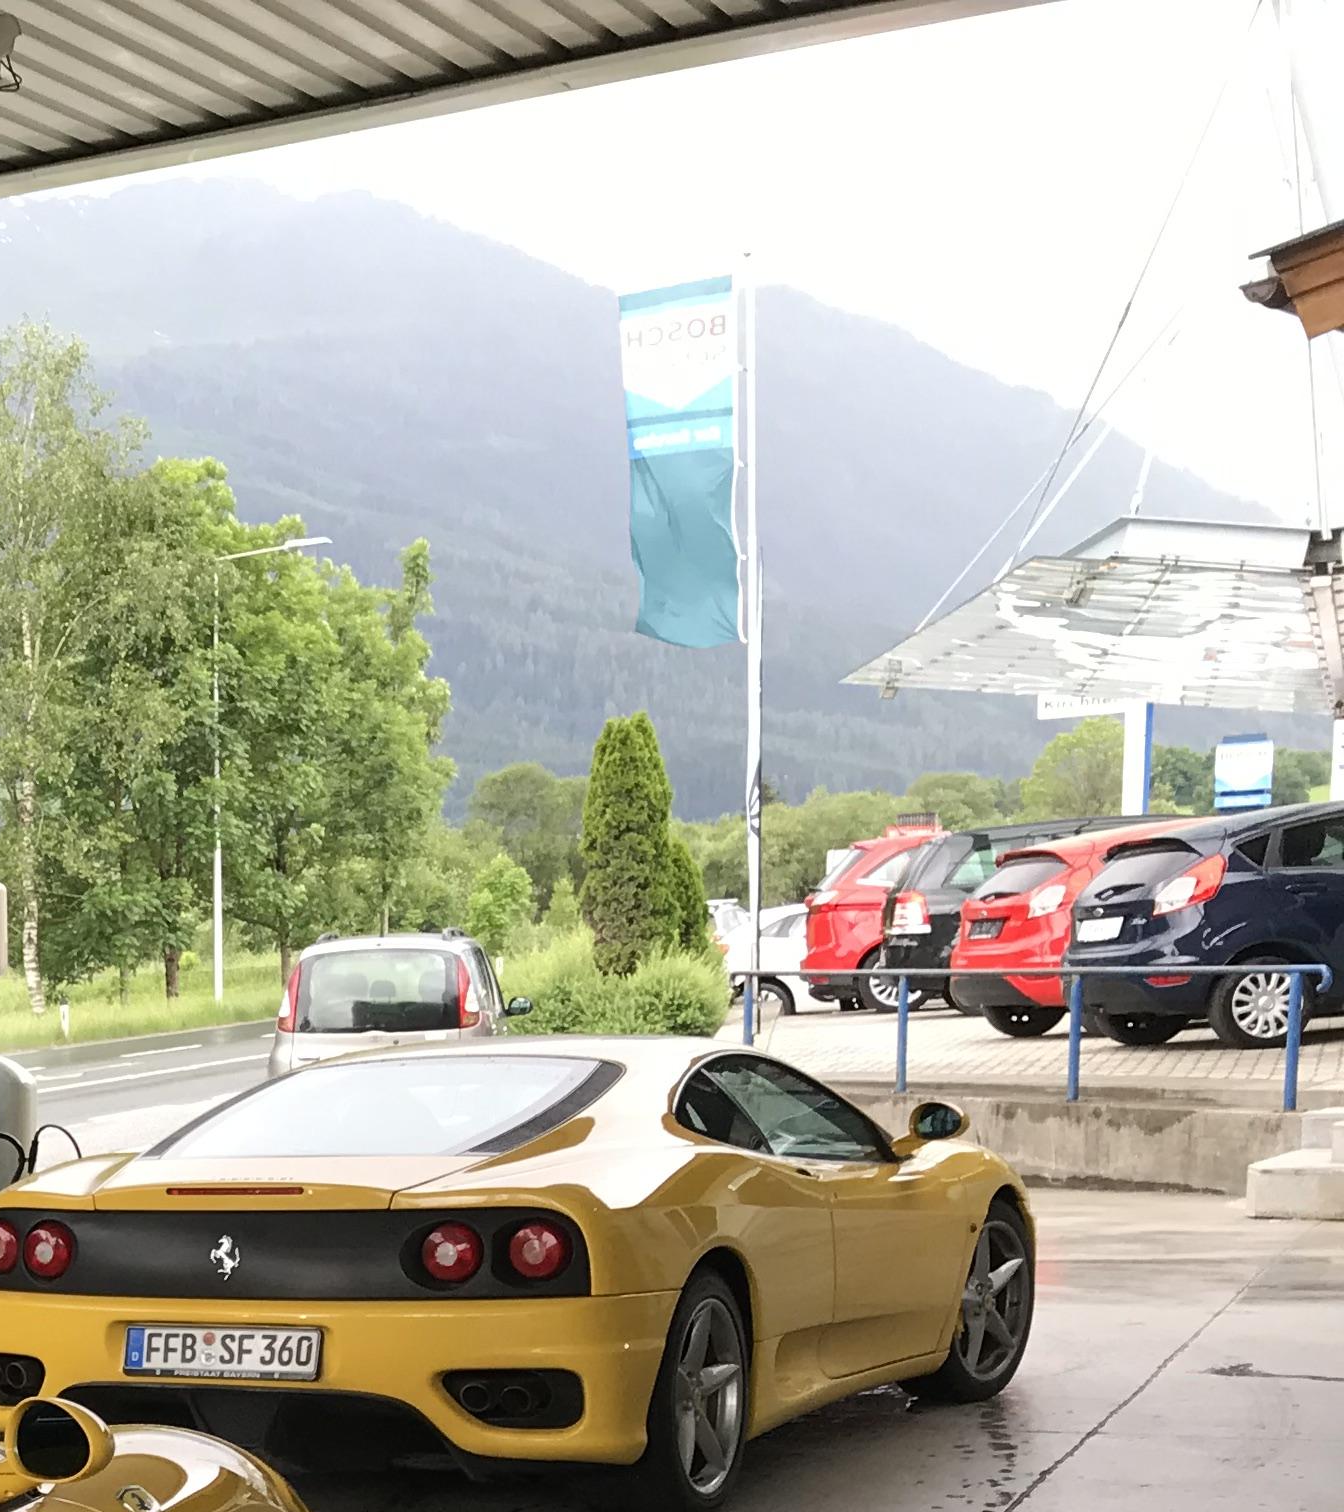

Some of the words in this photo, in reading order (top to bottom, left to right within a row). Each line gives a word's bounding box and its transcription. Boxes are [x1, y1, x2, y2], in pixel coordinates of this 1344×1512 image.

[131, 1351, 139, 1361] D
[146, 1333, 197, 1363] FFB
[220, 1334, 255, 1364] SF
[260, 1335, 313, 1366] 360
